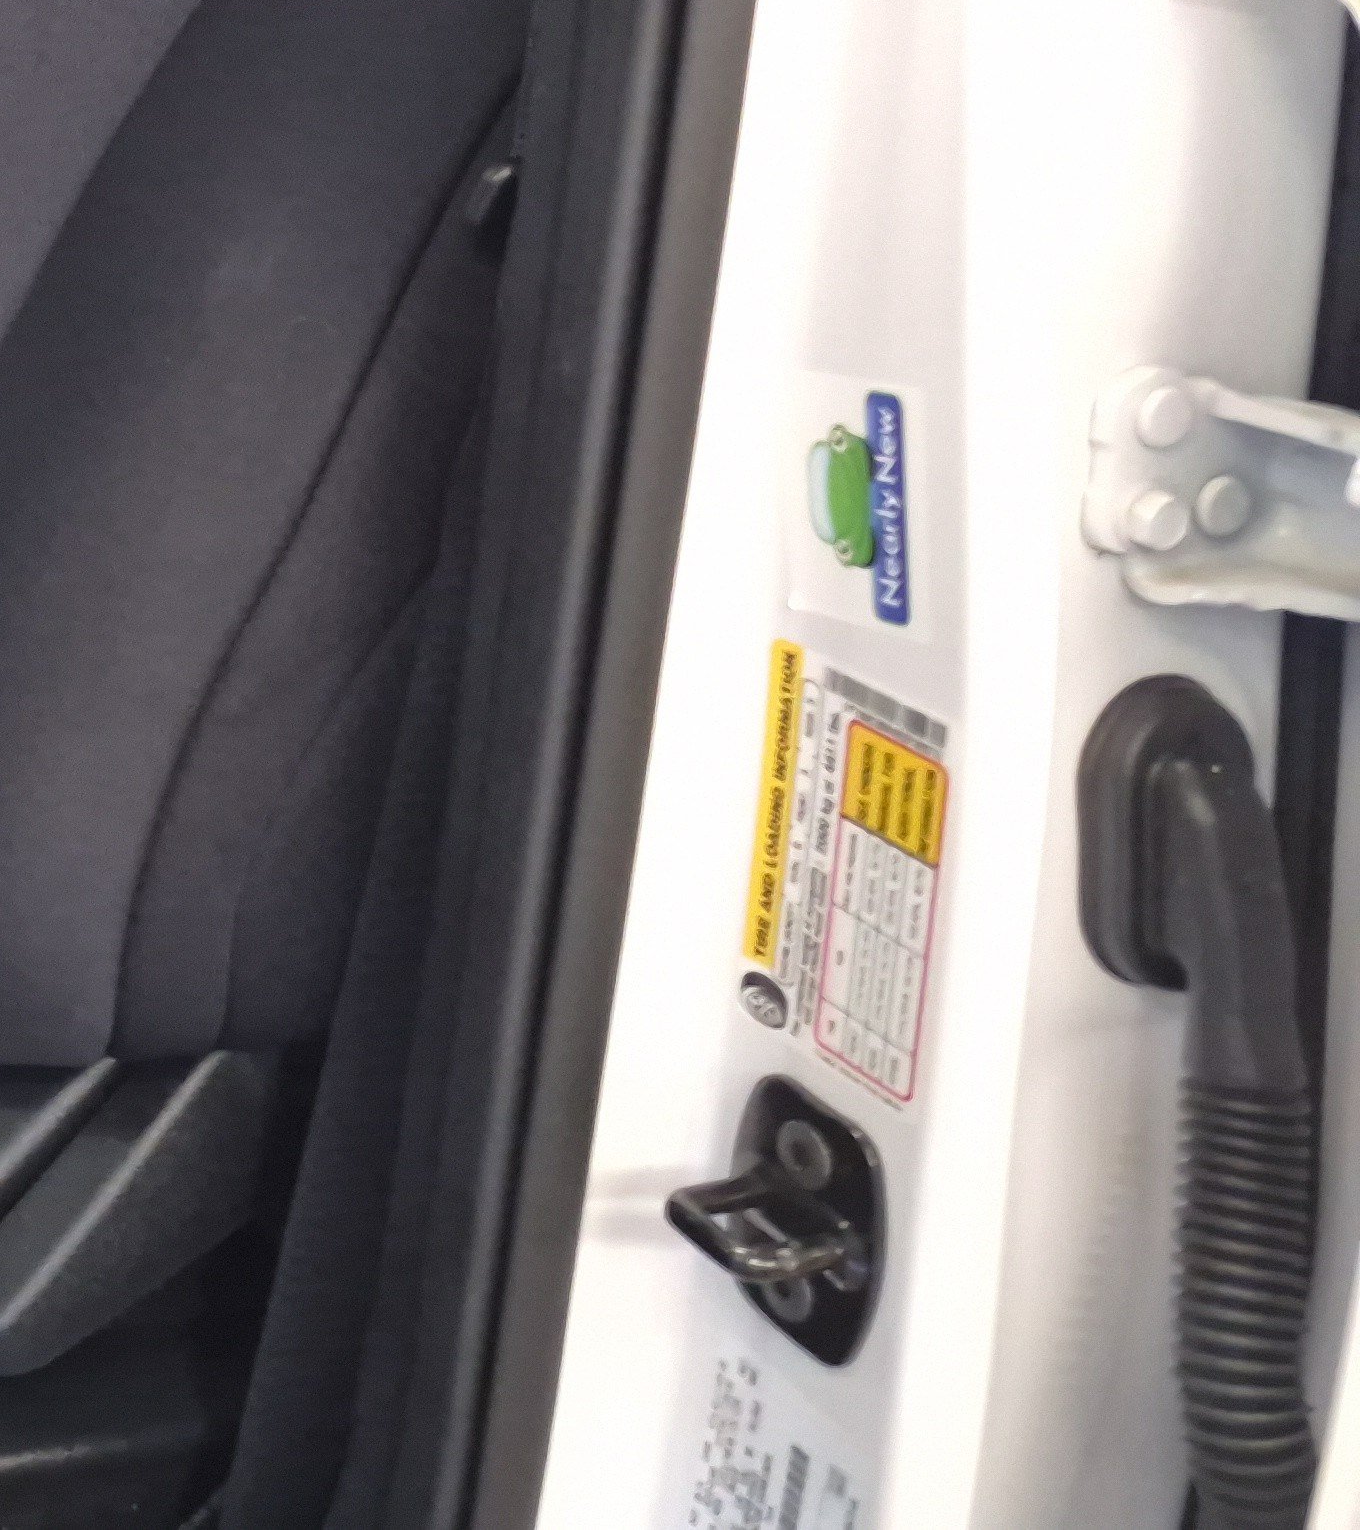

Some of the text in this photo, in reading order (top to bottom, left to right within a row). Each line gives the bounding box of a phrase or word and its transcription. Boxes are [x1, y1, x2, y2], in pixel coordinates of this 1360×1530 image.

[872, 406, 904, 608] Nearly New
[759, 871, 776, 914] AND
